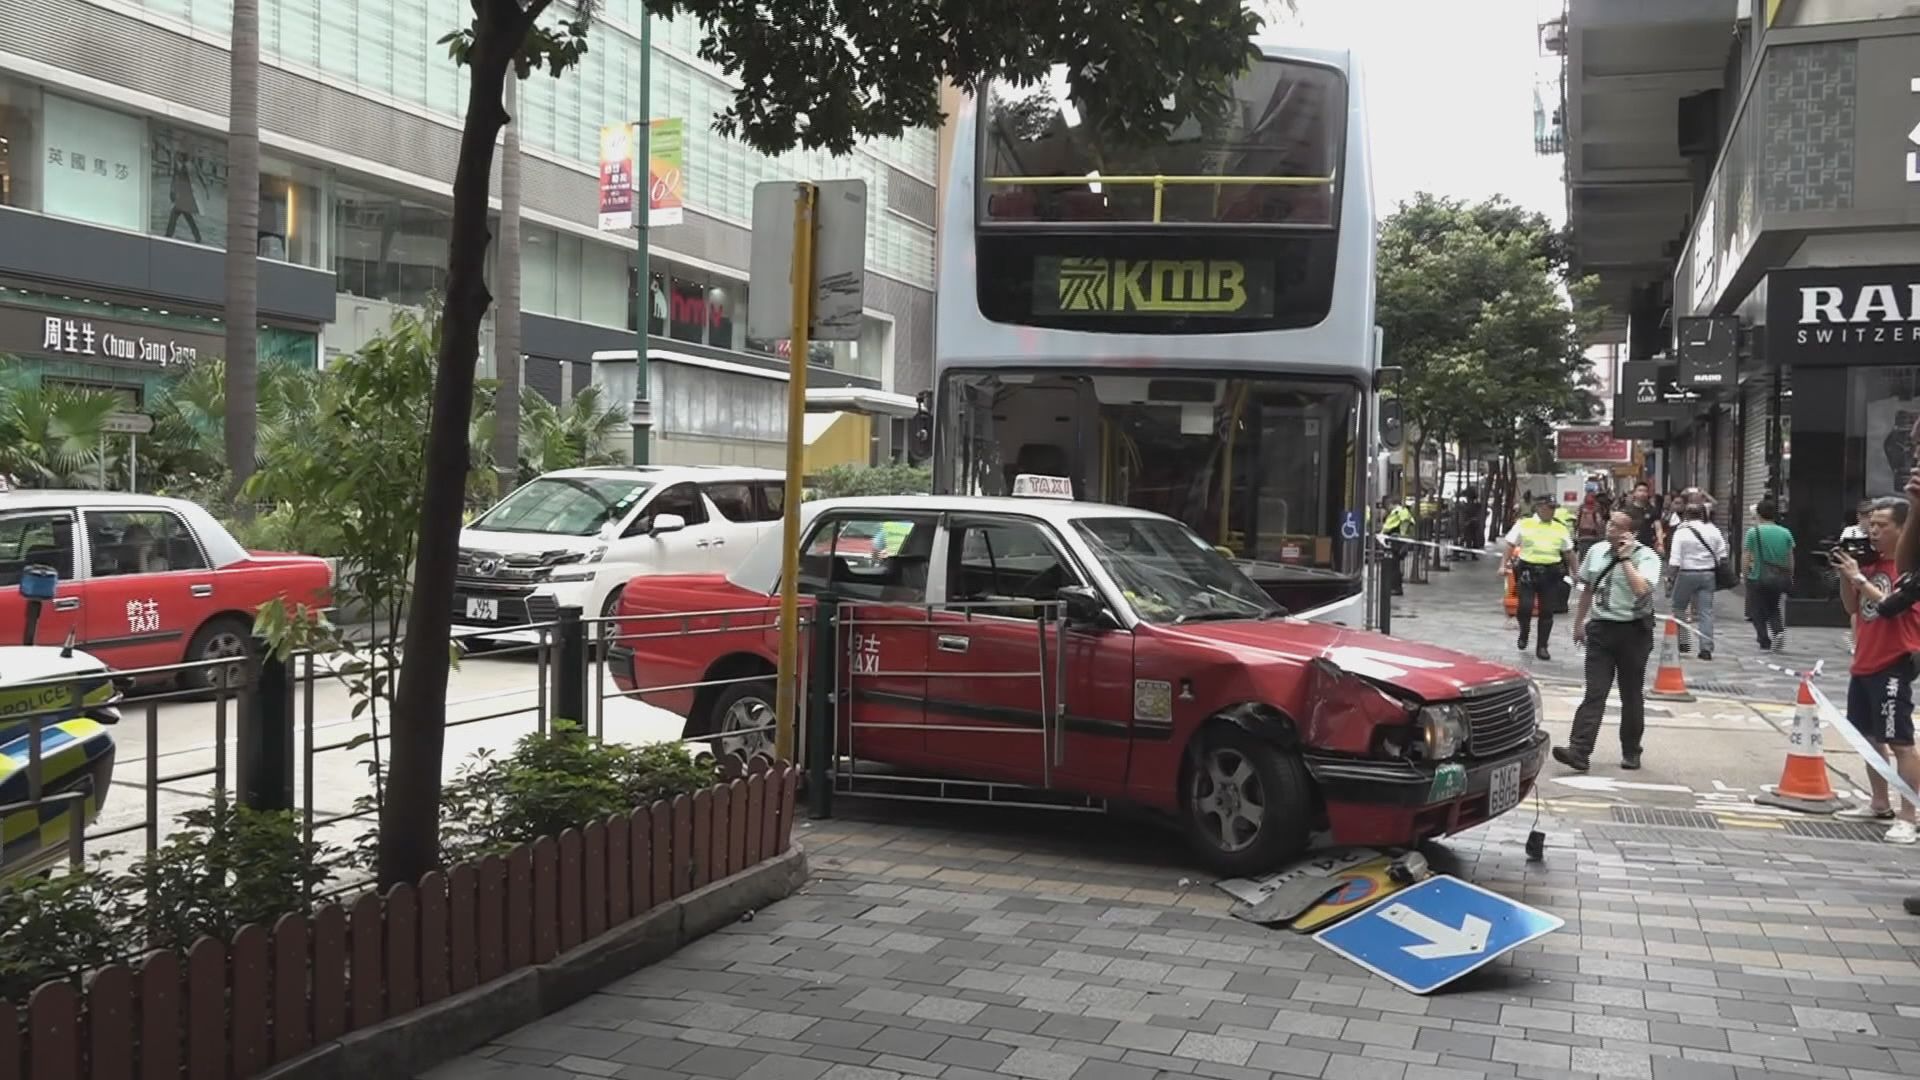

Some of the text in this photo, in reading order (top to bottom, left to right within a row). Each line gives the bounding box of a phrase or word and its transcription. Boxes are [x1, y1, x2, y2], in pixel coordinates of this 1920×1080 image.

[1112, 258, 1247, 312] KMB
[671, 288, 724, 328] hmv
[43, 316, 96, 355] 周生生
[102, 332, 136, 360] Chow
[138, 336, 167, 367] Sang
[1029, 476, 1070, 495] TAXI
[126, 598, 159, 620] 的士
[129, 613, 160, 632] TAXI
